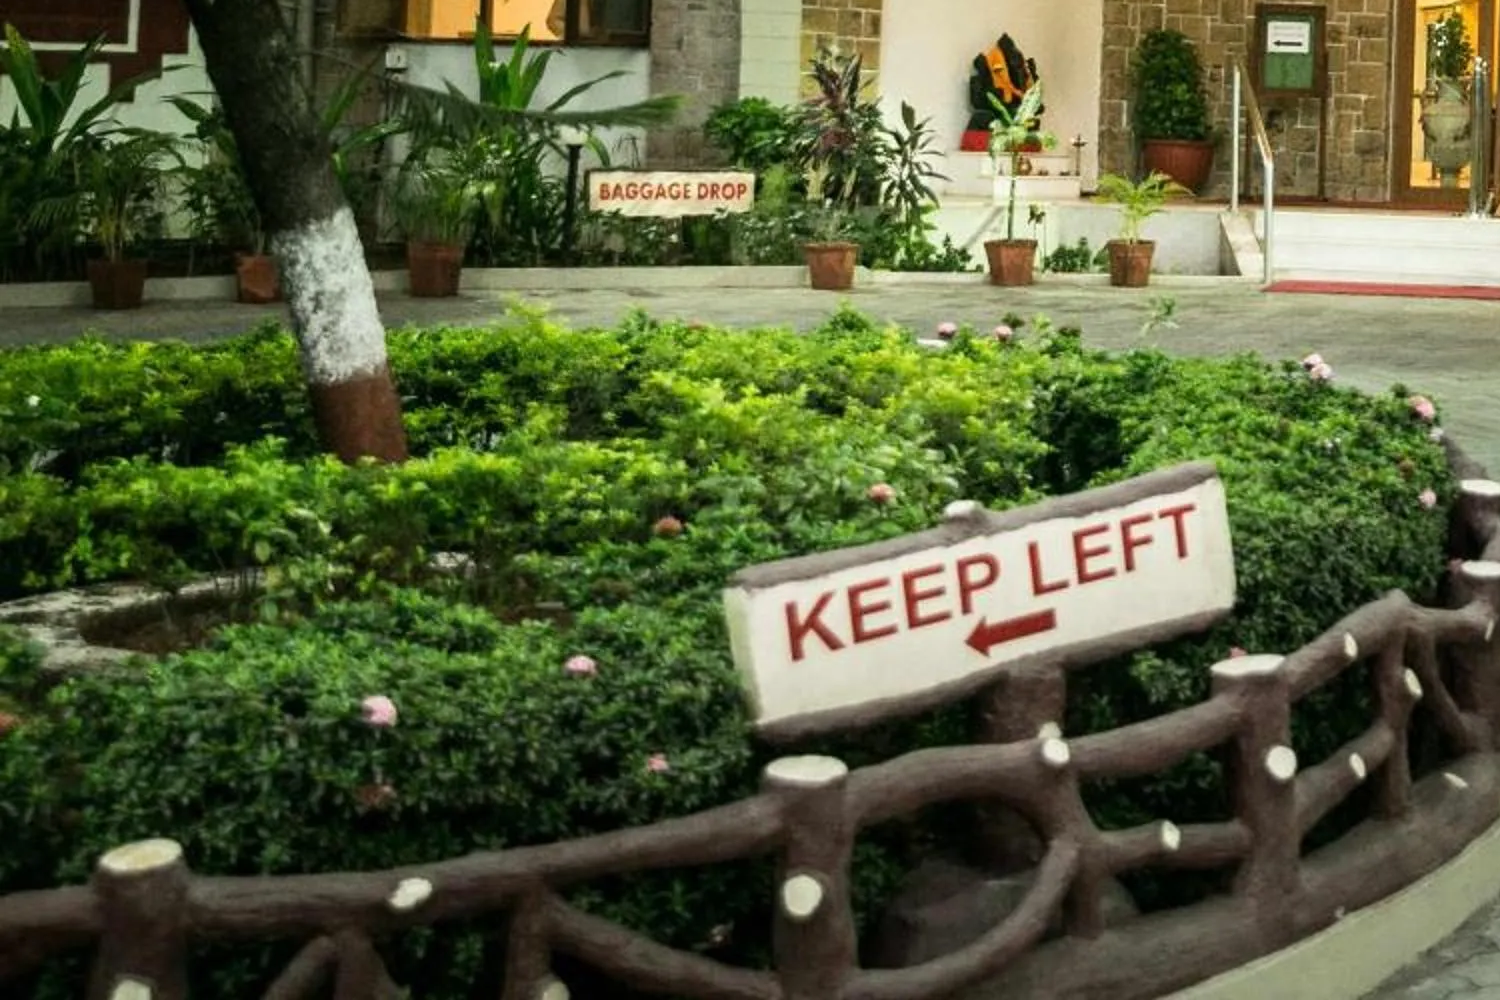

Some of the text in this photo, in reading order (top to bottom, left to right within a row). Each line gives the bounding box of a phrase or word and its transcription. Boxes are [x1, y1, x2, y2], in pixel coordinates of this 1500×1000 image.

[599, 182, 747, 200] BAGGAGE DROP
[785, 504, 1197, 662] KEEP LEFT
